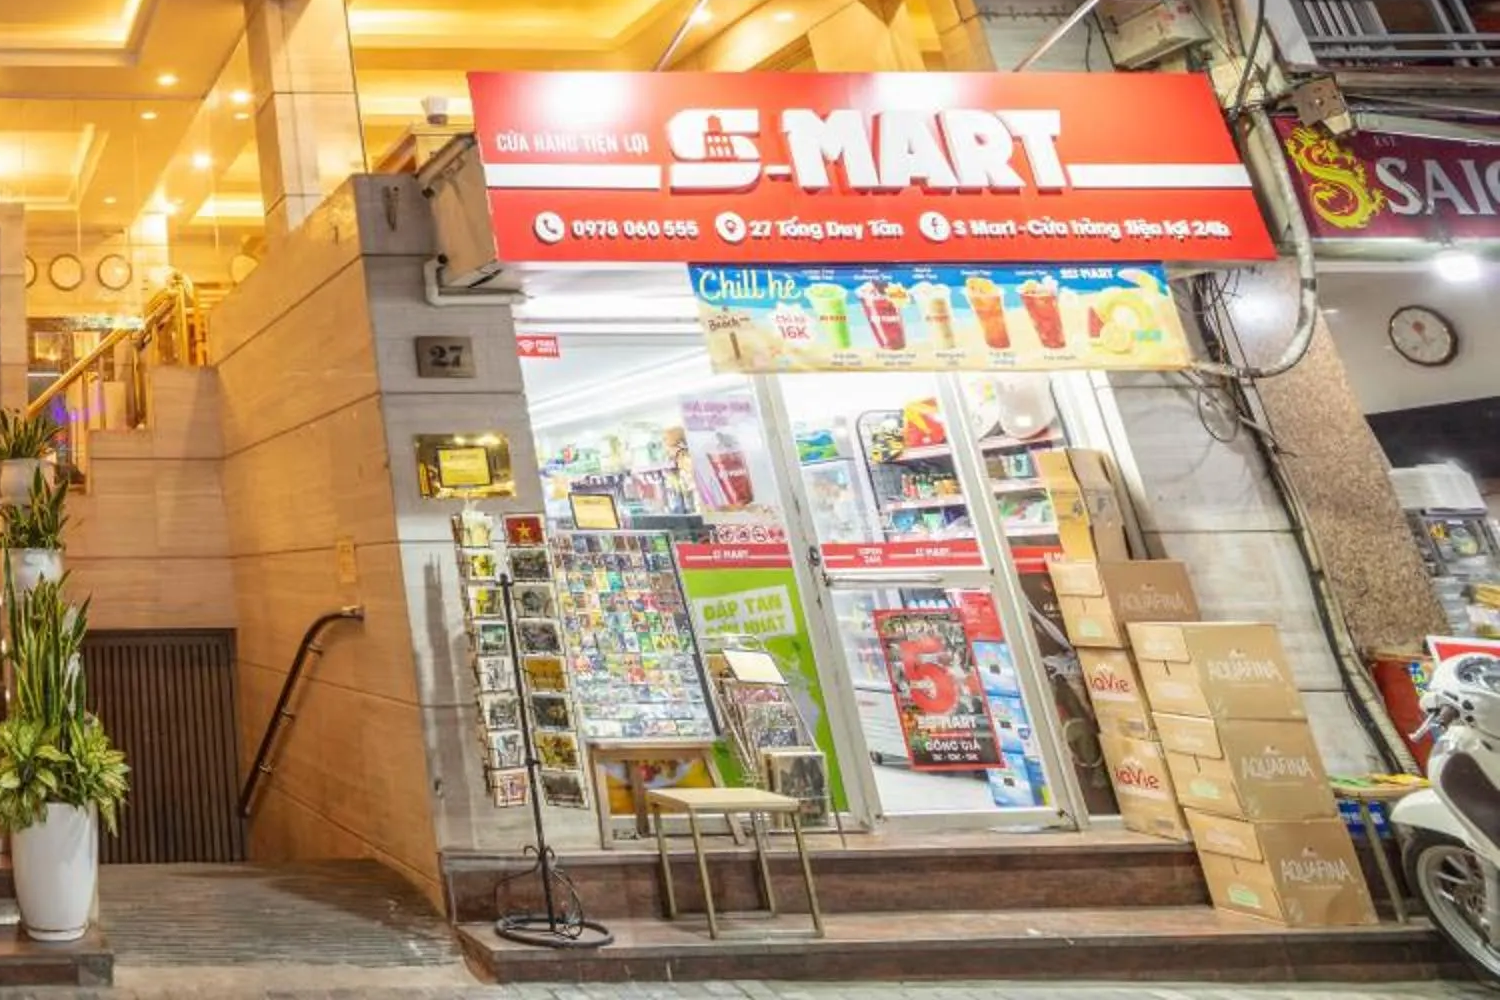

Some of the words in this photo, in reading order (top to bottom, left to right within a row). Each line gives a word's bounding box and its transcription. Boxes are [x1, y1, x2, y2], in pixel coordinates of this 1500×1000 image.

[572, 219, 619, 238] 0978
[623, 219, 661, 238] 060
[663, 219, 700, 239] 555
[749, 219, 773, 239] 27
[826, 220, 864, 241] Duy
[699, 268, 766, 300] Chill
[429, 345, 464, 368] 27
[1207, 659, 1284, 682] AQUAFINA
[1241, 756, 1318, 780] AQUAFINA
[1280, 857, 1354, 883] AQUAFINA
